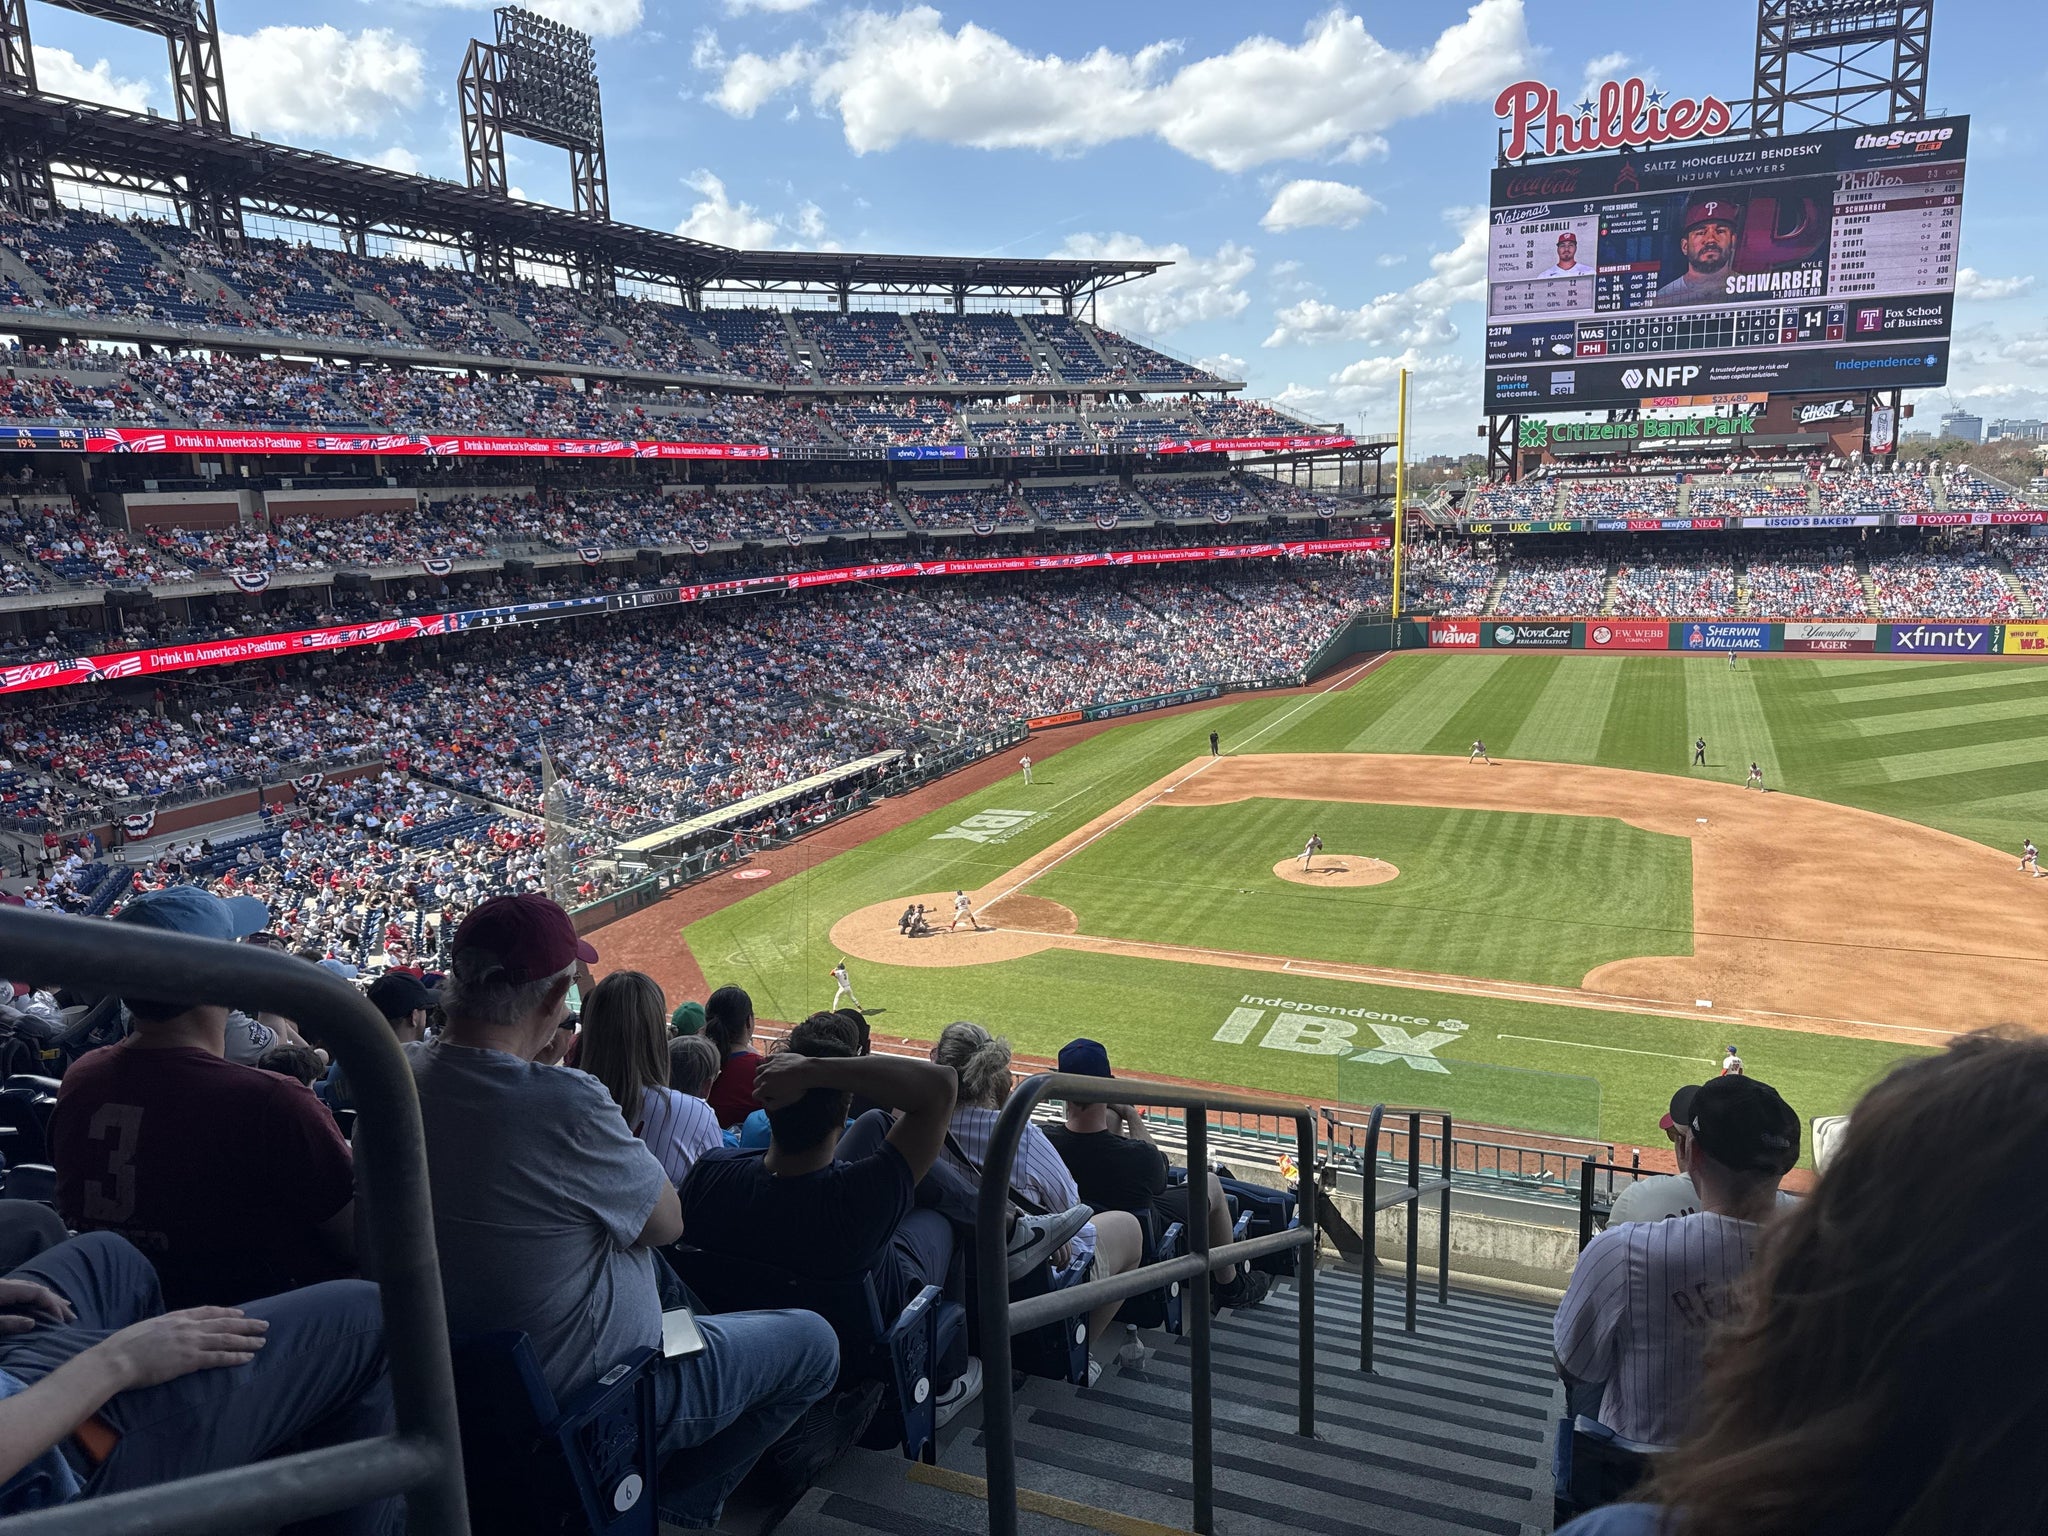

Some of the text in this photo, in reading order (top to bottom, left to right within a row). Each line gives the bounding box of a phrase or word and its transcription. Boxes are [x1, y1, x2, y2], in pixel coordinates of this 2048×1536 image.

[1494, 77, 1731, 160] Phillies
[1854, 128, 1953, 149] theScore
[1917, 142, 1941, 151] BET
[1644, 144, 1822, 172] SALTZ MONGELUZZI BENDESKY
[1677, 163, 1785, 182] INJURY LAWYERS
[1836, 171, 1903, 191] Phillies
[1846, 193, 1872, 202] TURNER
[1615, 202, 1638, 211] SEQUENCE
[1845, 203, 1886, 214] SCHWARBER
[1495, 204, 1594, 225] Nationals 3-2
[1844, 216, 1870, 225] HARPER
[1505, 221, 1570, 235] 24 CADE CAVALLI
[1842, 239, 1864, 247] STOTT
[1841, 249, 1866, 259] GARCÍA
[1801, 261, 1823, 269] KYLE
[1841, 261, 1864, 270] MARSH
[1725, 269, 1822, 294] SCHWARBER
[1840, 272, 1875, 281] REALMUTO
[1839, 283, 1875, 292] CRAWFORD
[1885, 306, 1941, 318] Fox School
[1580, 310, 1821, 339] WAS 1-1
[1884, 317, 1943, 328] of Business
[1488, 327, 1512, 336] 2:37 PM
[1583, 344, 1601, 353] PHI
[1507, 351, 1527, 359] (MPH)
[1835, 356, 1921, 371] Independence
[1736, 365, 1758, 374] partner
[1497, 374, 1527, 383] Driving
[1646, 365, 1699, 388] NFP
[1731, 373, 1751, 381] capital
[1496, 382, 1529, 390] smarter
[1495, 391, 1540, 399] outcomes.
[1712, 394, 1748, 404] $23,480
[1800, 400, 1841, 423] GHOST
[1552, 413, 1755, 442] Citizens Bank Park
[19, 429, 76, 438] K% BB%
[16, 438, 78, 449] 19% 14%
[174, 435, 301, 448] Drink in America's Pastime
[463, 440, 549, 452] Drink in America's Pastime
[1215, 441, 1231, 449] Drink
[1236, 441, 1261, 449] America's
[1261, 440, 1281, 448] Pastime
[897, 450, 915, 458] xfinity
[1765, 517, 1856, 526] LISCIO'S BAKERY
[1921, 515, 1967, 524] TOYOTA
[1996, 513, 2043, 522] TOYOTA
[1470, 524, 1492, 533] UKG
[1509, 523, 1531, 532] UKG
[1548, 522, 1571, 531] UKG
[1630, 521, 1657, 529] NECA
[1694, 519, 1723, 528] NECA
[1328, 541, 1351, 549] America's
[1352, 540, 1372, 548] Pastime
[1137, 553, 1151, 561] Drink
[1152, 552, 1158, 560] in
[950, 563, 966, 571] Drink
[973, 562, 1001, 570] America's
[1002, 560, 1025, 568] Pastime
[616, 594, 637, 608] 1-1
[481, 618, 489, 626] 29
[495, 616, 503, 624] 36
[1516, 627, 1570, 638] NovaCare
[1634, 629, 1663, 637] WEBB
[1707, 625, 1760, 637] SHERWIN
[1800, 624, 1859, 639] Yuengling
[1432, 630, 1477, 644] Wawa
[1897, 626, 1982, 649] xfinity
[1705, 637, 1761, 648] WILLIAMS.
[1810, 641, 1847, 649] LAGER
[2019, 638, 2048, 650] W.B.
[150, 640, 287, 667] Drink in America's Pastime
[1240, 994, 1431, 1026] Independence
[1211, 1006, 1463, 1075] IBX
[83, 1103, 145, 1223] 3
[625, 1484, 633, 1500] 6
